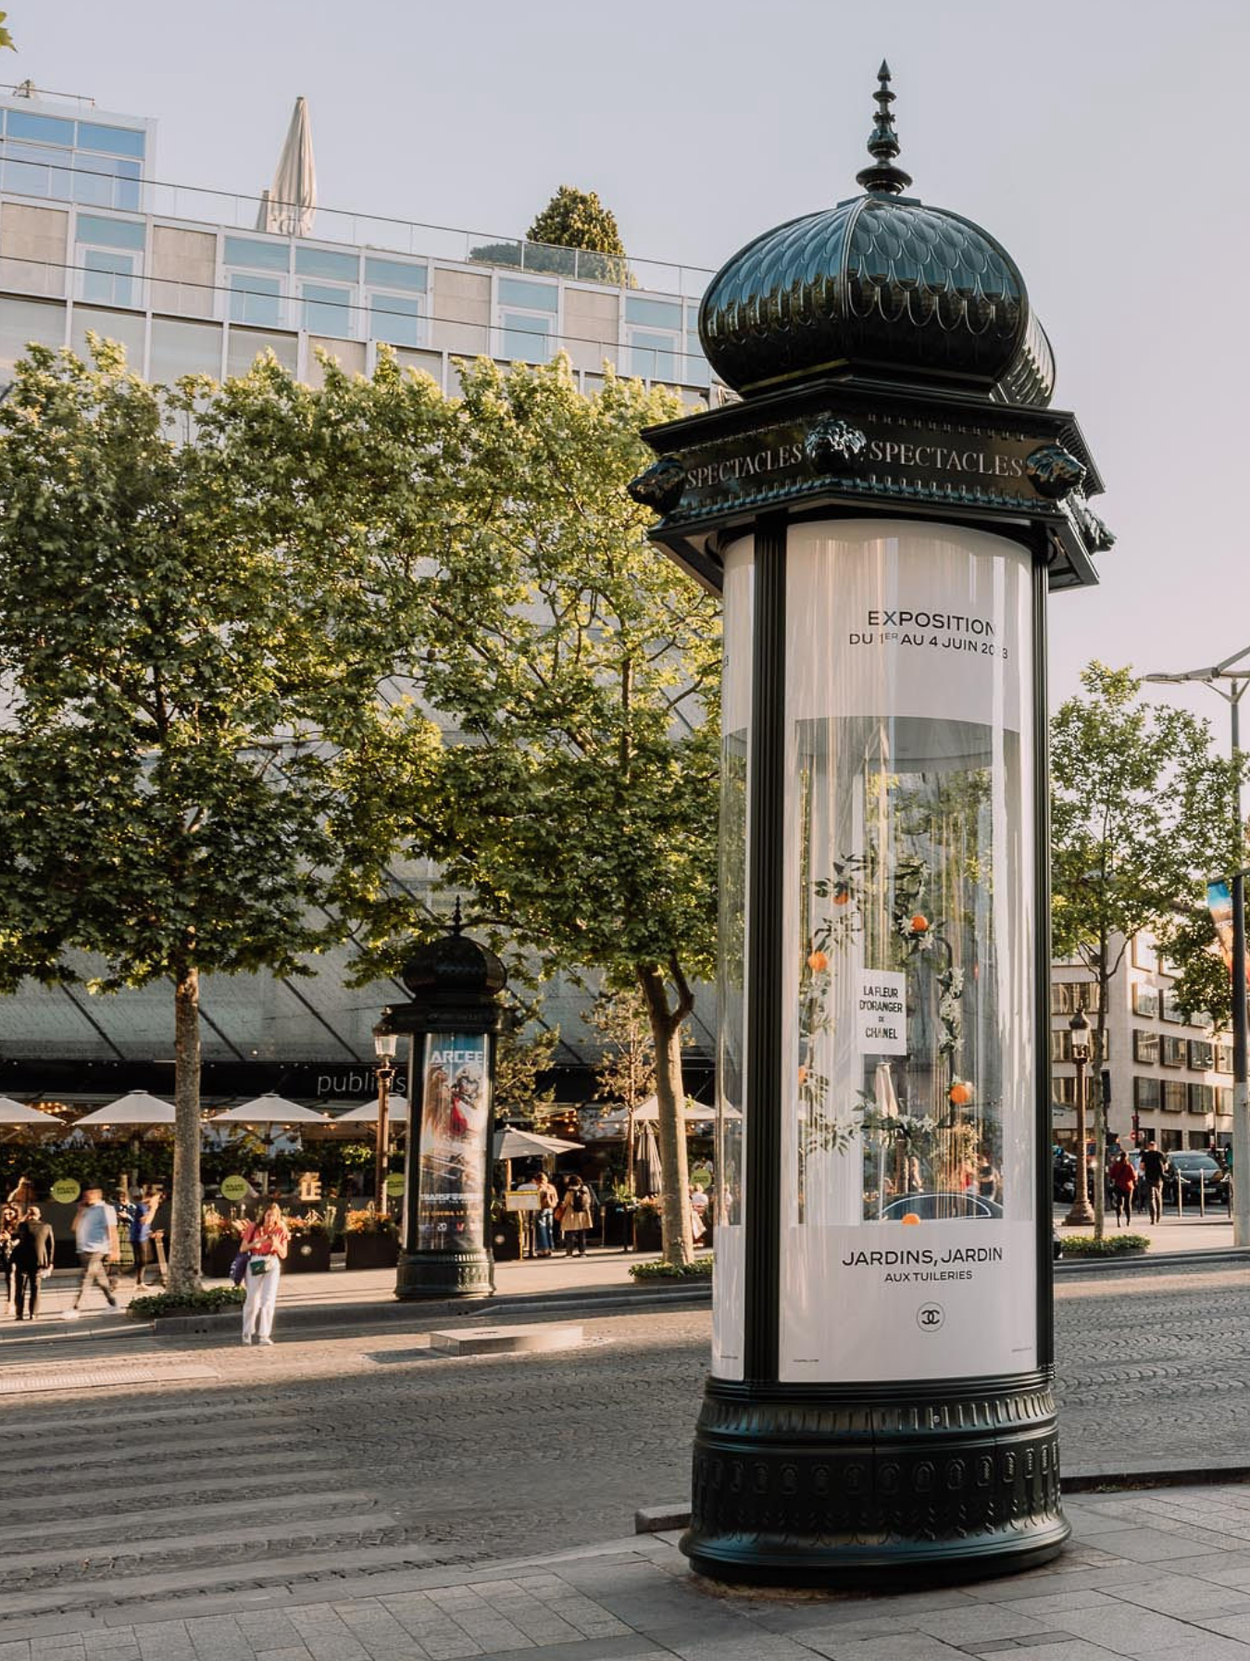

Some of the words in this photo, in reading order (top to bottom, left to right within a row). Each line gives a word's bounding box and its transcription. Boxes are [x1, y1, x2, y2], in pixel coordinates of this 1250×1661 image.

[686, 443, 803, 489] SPECTACLES
[869, 440, 1023, 477] SPECTACLES
[868, 610, 994, 637] EXPOSITION
[849, 633, 873, 646] DU
[900, 633, 925, 647] AU
[928, 636, 939, 647] 4
[942, 637, 978, 653] JUIN
[981, 642, 1009, 660] 203
[430, 1050, 484, 1064] ARCEE
[317, 1071, 407, 1096] publiis
[842, 1250, 938, 1267] JARDINS,
[941, 1247, 1003, 1264] JARDIN
[884, 1272, 911, 1283] AUX
[913, 1270, 973, 1282] TUILERIES
